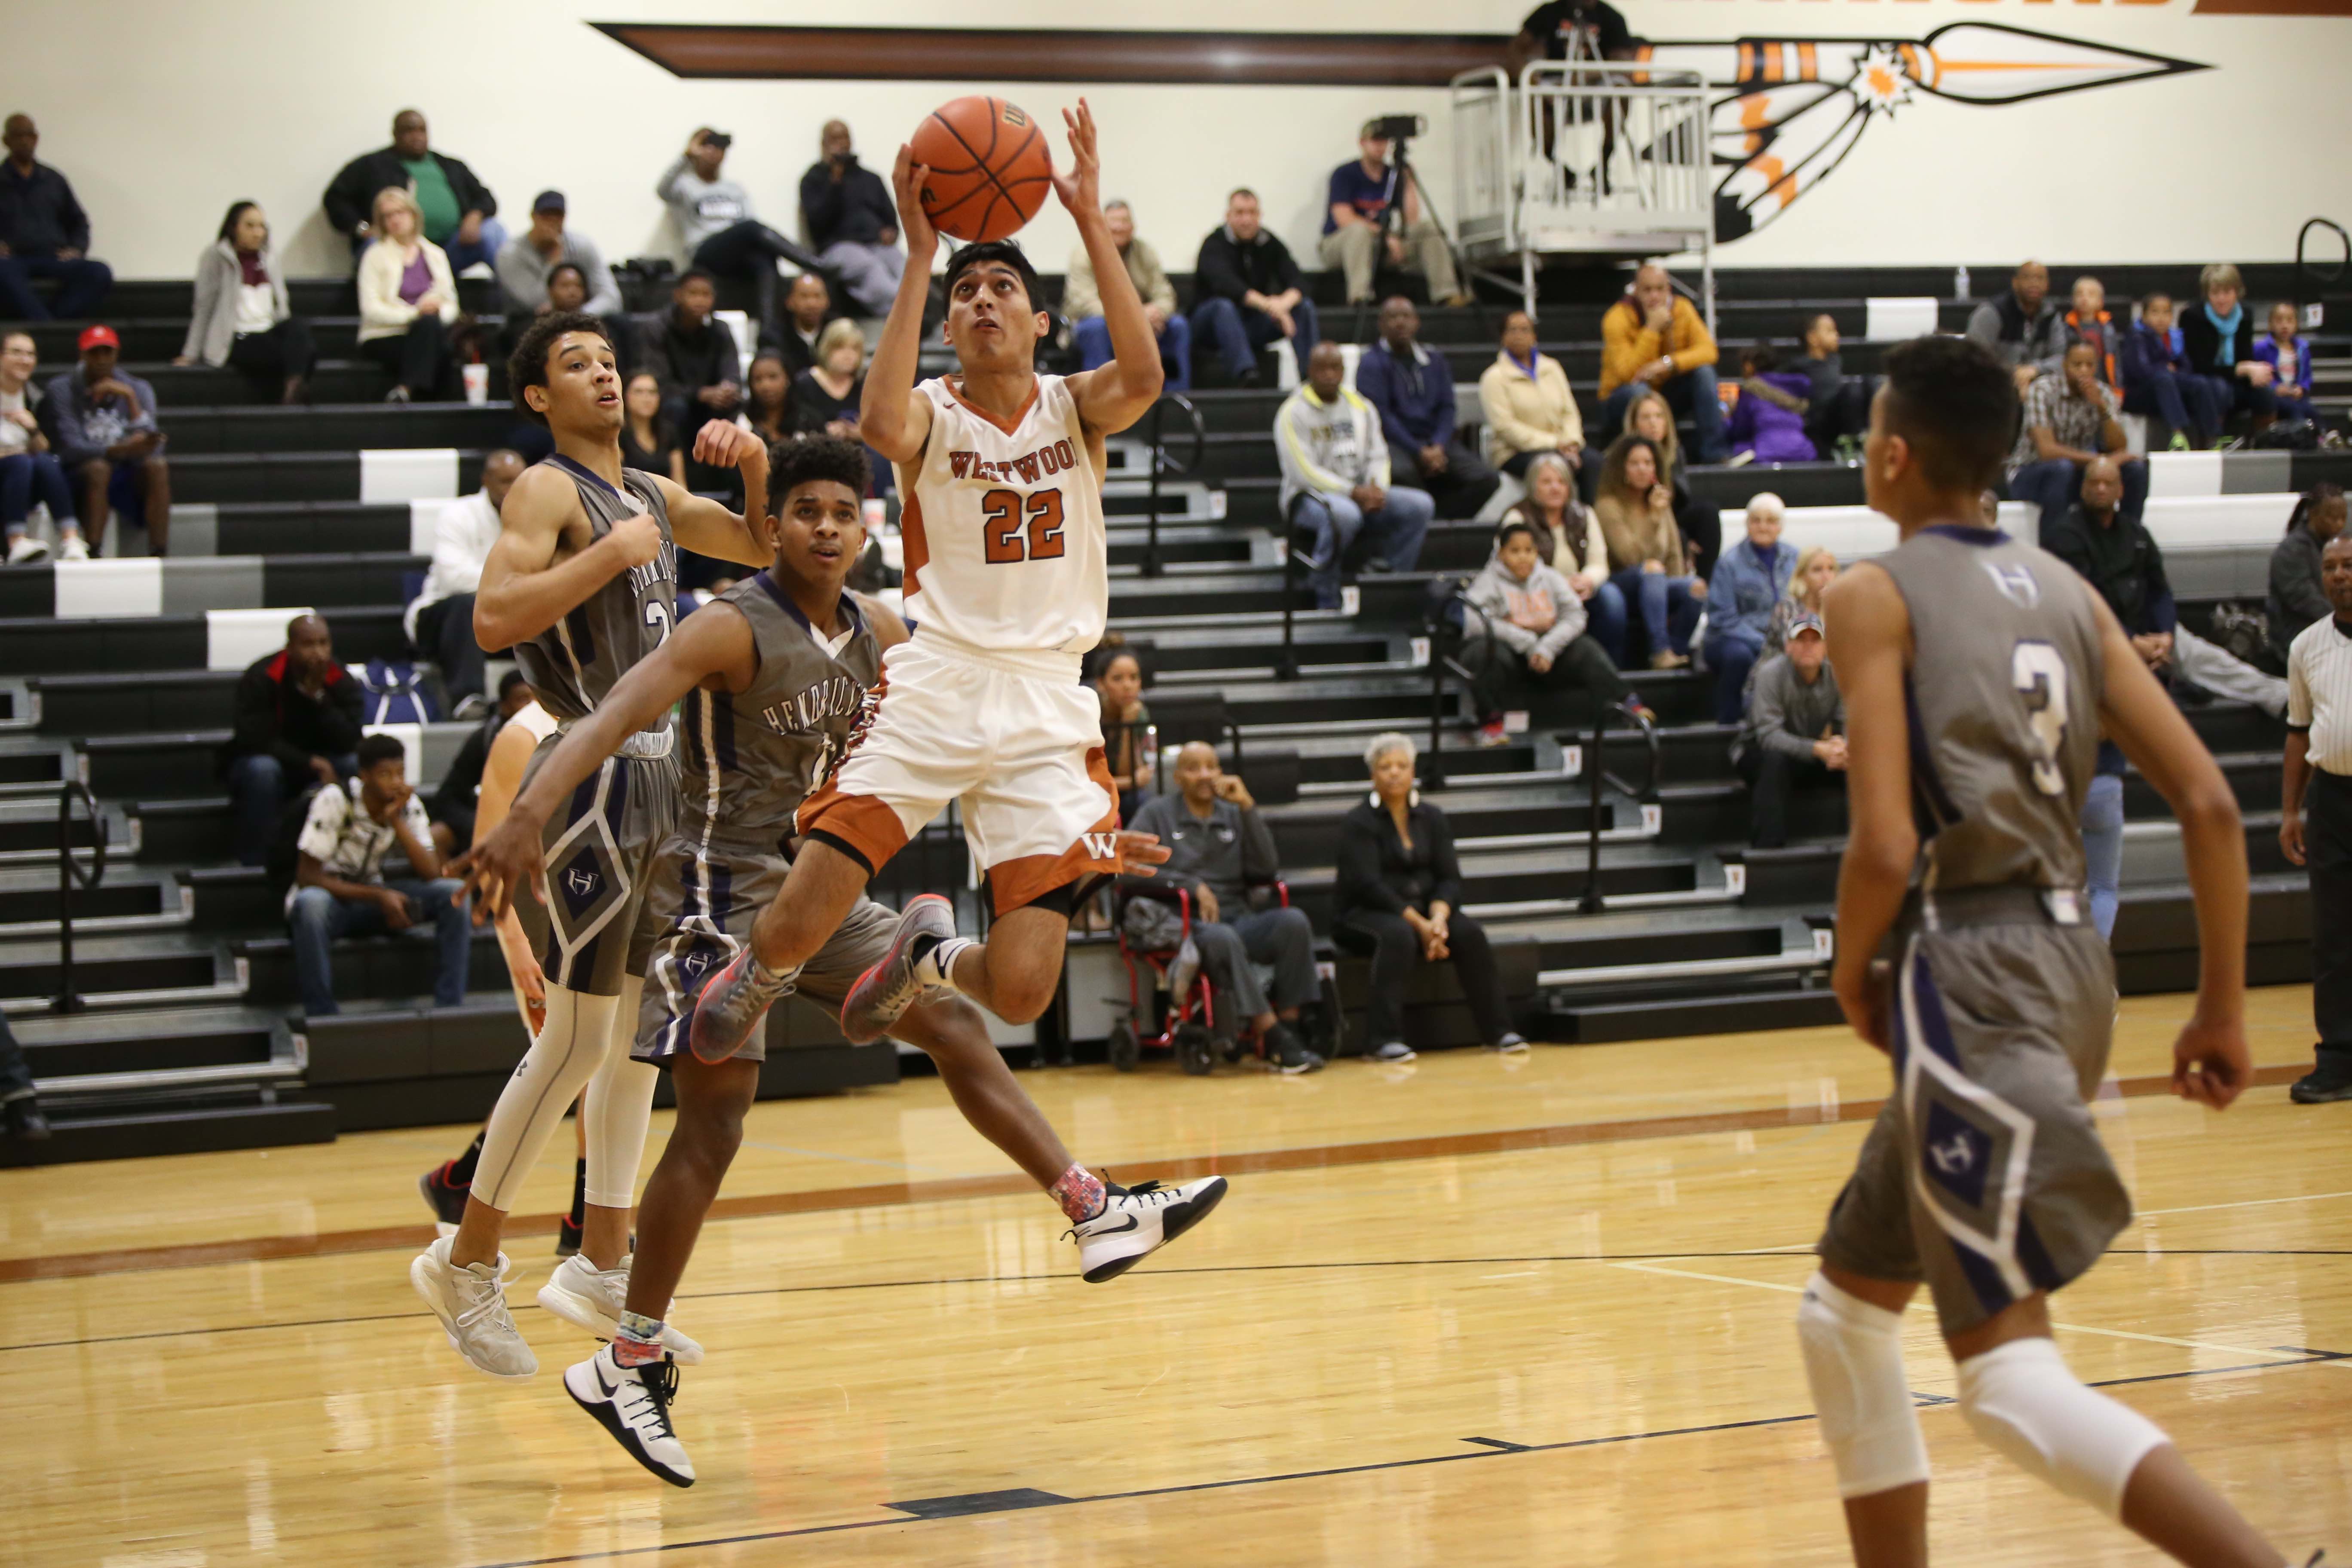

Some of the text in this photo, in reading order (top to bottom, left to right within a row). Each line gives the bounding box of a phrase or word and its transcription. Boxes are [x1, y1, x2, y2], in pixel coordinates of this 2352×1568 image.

[949, 437, 1079, 484] WESTWOO
[982, 487, 1065, 564] 22
[2012, 640, 2067, 795] 3
[1080, 832, 1117, 860] W
[568, 868, 599, 896] H
[685, 952, 714, 977] H
